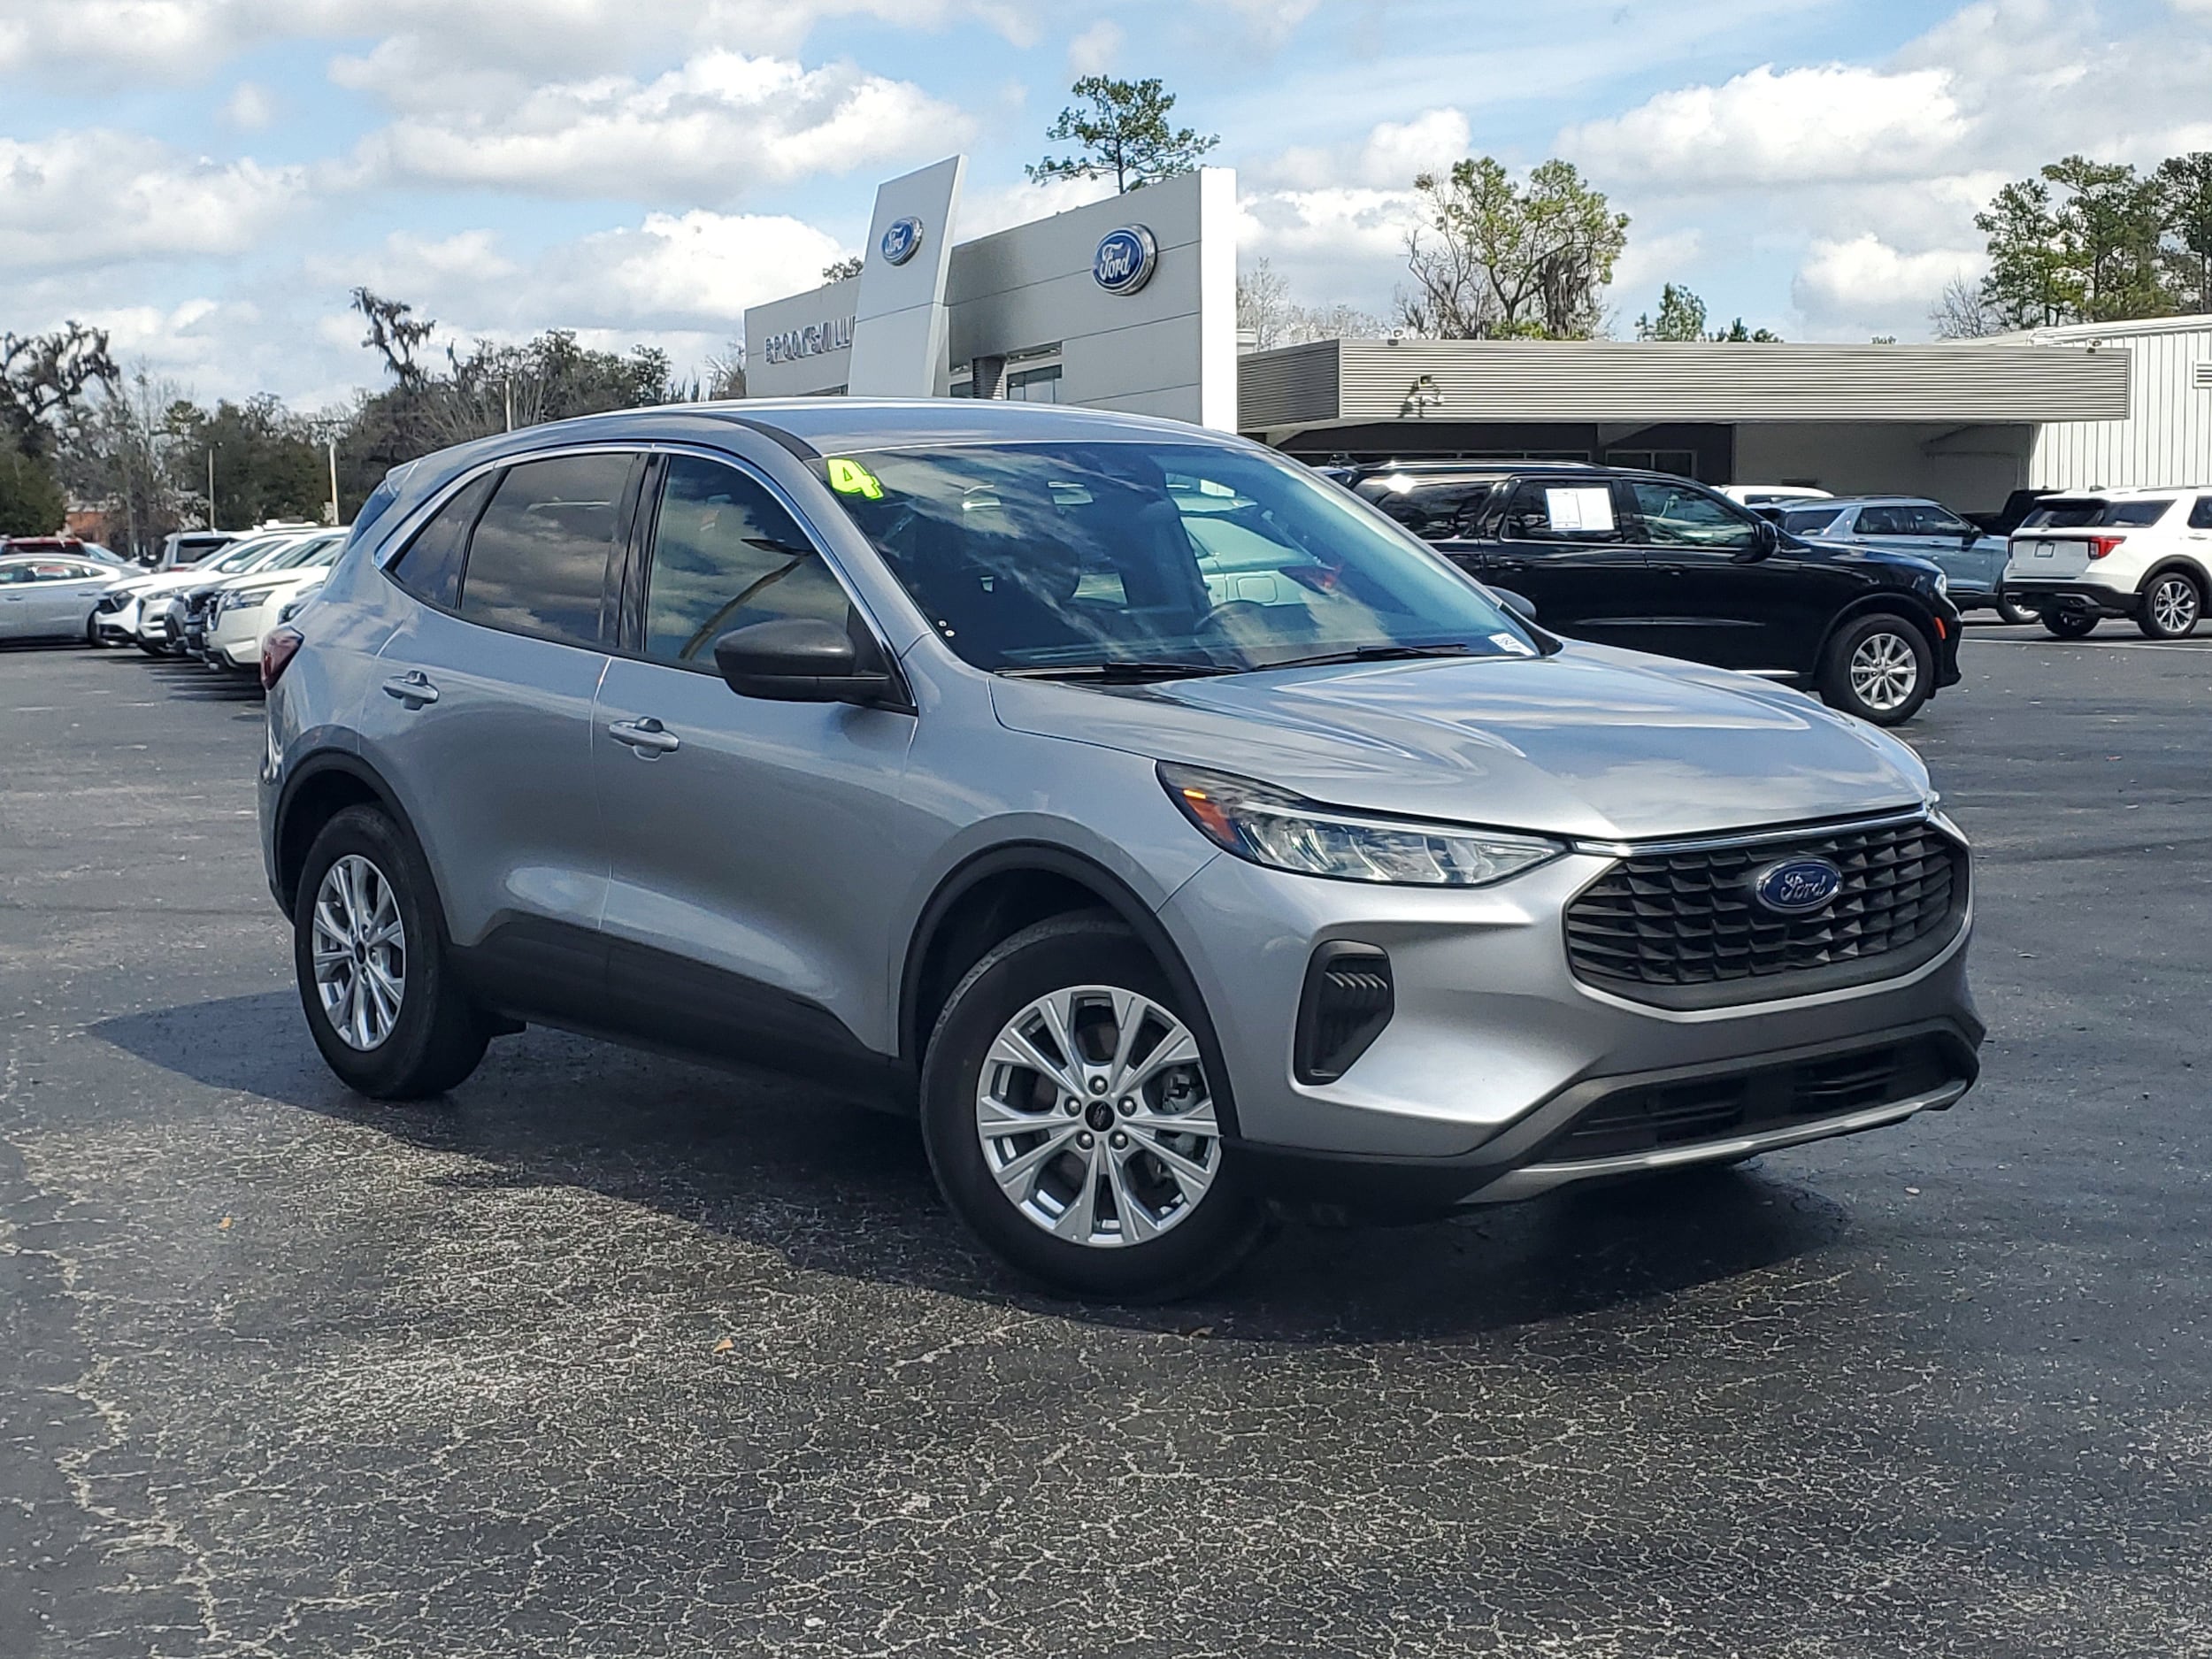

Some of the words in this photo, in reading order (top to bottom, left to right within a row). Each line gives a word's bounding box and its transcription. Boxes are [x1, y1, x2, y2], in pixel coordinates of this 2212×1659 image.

[885, 227, 907, 255] Ford
[1099, 242, 1131, 280] Ford
[1780, 871, 1827, 902] Ford
